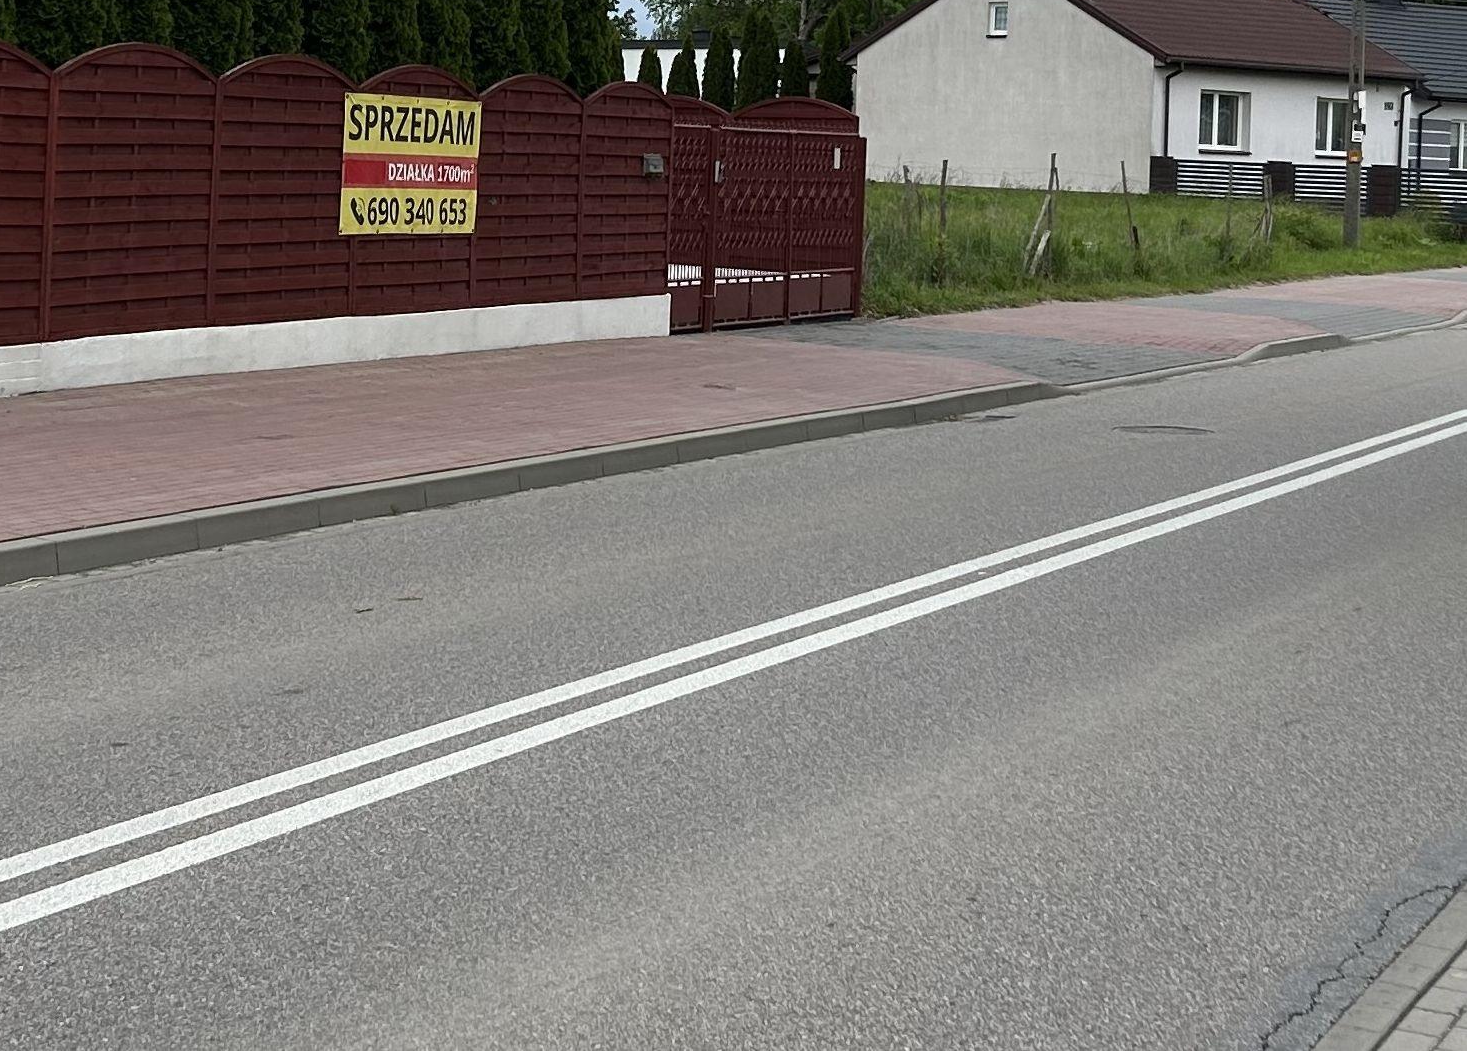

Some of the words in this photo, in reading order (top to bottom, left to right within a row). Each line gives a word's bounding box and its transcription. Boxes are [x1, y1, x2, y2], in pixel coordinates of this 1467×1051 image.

[349, 104, 476, 145] SPRZEDAM
[388, 163, 435, 181] DZIAŁKA
[368, 197, 400, 226] 690
[404, 198, 434, 226] 340
[439, 198, 466, 226] 653
